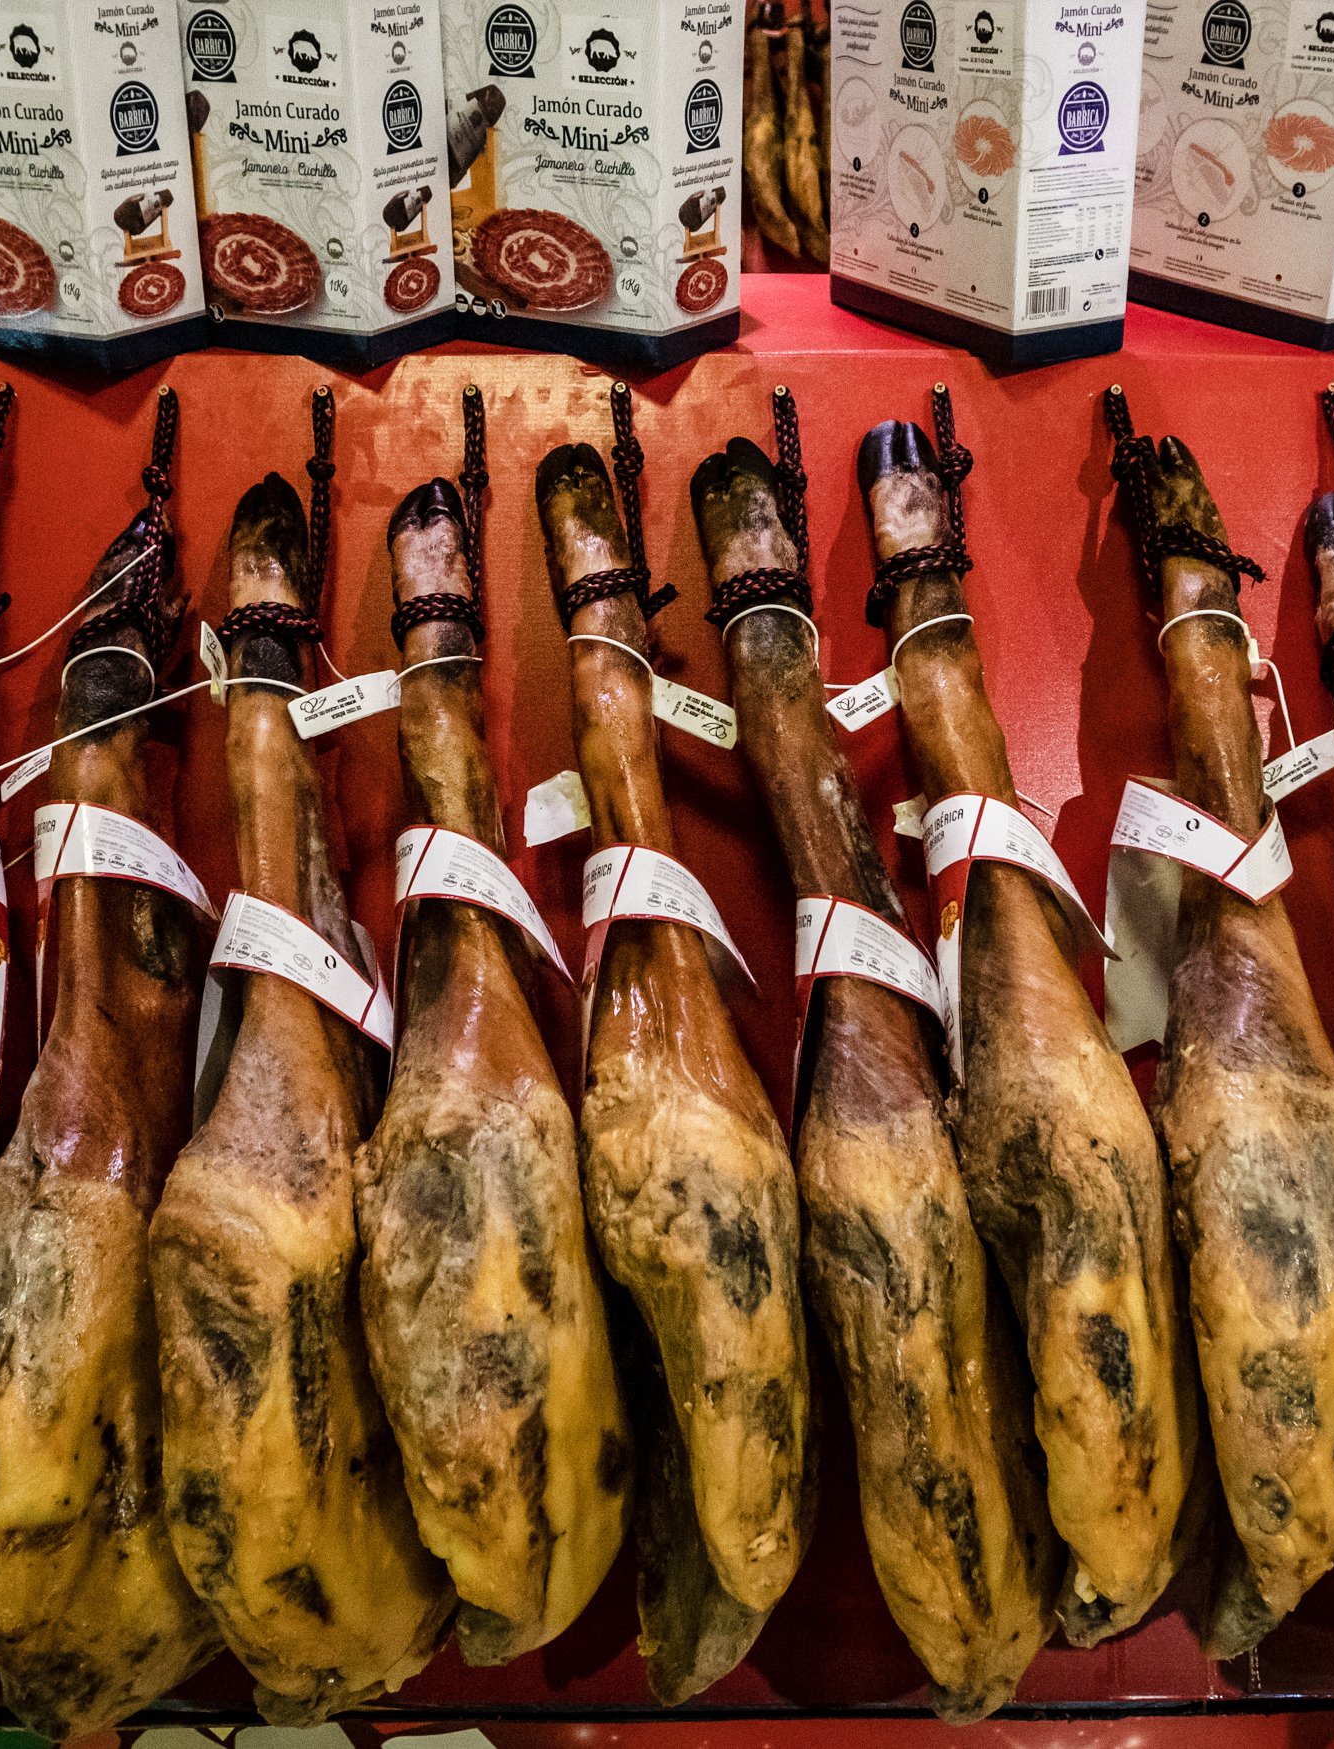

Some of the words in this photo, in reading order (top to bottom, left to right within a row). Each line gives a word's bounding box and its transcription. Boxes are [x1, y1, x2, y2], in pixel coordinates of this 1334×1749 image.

[98, 7, 124, 19] Jamón
[126, 5, 154, 16] Curado
[373, 6, 395, 20] Jamón
[396, 4, 421, 16] Curado
[684, 5, 706, 19] Jamón
[707, 3, 731, 16] Curado
[1060, 5, 1089, 19] Jamón
[1091, 4, 1122, 15] Curado
[115, 22, 140, 37] Mini
[387, 21, 408, 38] Mini
[696, 20, 717, 36] Mini
[1076, 22, 1102, 37] Mini
[1210, 23, 1242, 43] BARRICA
[194, 37, 228, 56] BARRICA
[494, 30, 528, 51] BARRICA
[282, 74, 329, 88] SELECCIÓN
[578, 74, 628, 86] SELECCIÓN
[894, 73, 916, 88] Jamón
[918, 77, 946, 92] Curado
[1188, 67, 1219, 83] Jamón
[1222, 73, 1258, 89] Curado
[532, 95, 582, 116] Jamón
[586, 99, 643, 119] Curado
[907, 94, 929, 114] Mini
[1203, 89, 1234, 109] Mini
[15, 103, 63, 121] Curado
[118, 109, 150, 128] BARRICA
[235, 99, 282, 120] Jamón
[286, 103, 340, 121] Curado
[389, 108, 415, 127] BARRICA
[691, 105, 717, 125] BARRICA
[1066, 108, 1100, 128] BARRICA
[264, 128, 311, 155] Mini
[561, 125, 609, 152] Mini
[29, 163, 64, 179] Cuchillo
[241, 158, 289, 177] Jamonero
[297, 162, 337, 178] Cuchillo
[535, 154, 585, 173] Jamonero
[594, 158, 635, 177] Cuchillo
[329, 278, 349, 297] 1Kg
[620, 277, 642, 297] 1Kg
[934, 808, 964, 832] IBÉRICA
